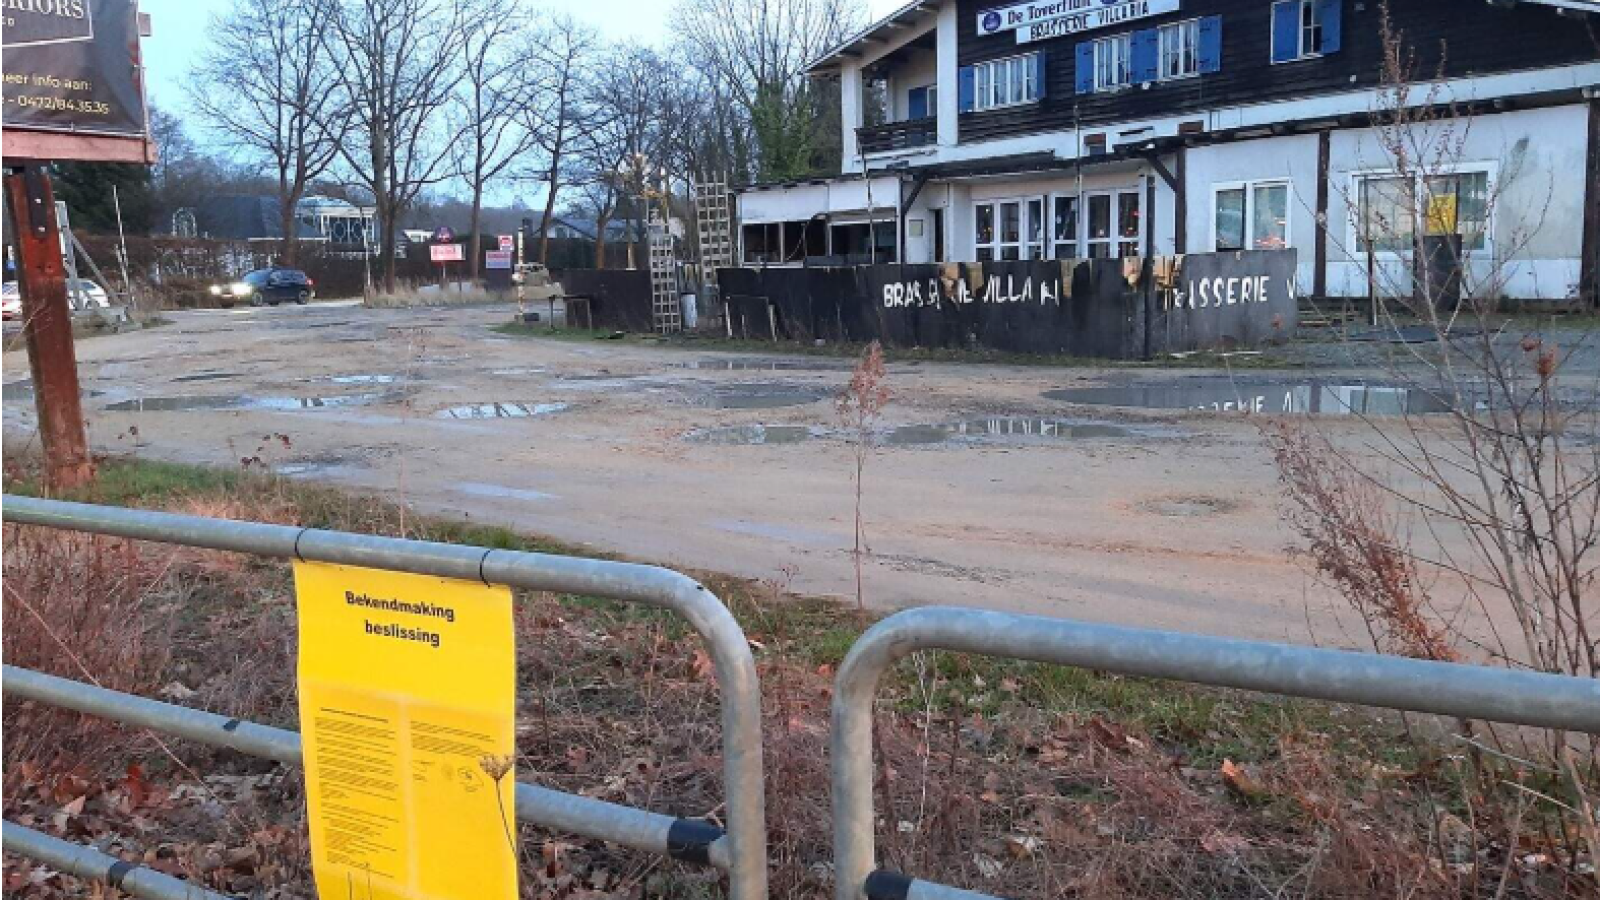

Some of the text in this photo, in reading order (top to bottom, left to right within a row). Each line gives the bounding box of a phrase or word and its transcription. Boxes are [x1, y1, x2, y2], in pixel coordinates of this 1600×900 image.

[2, 0, 84, 18] RIORS
[1007, 10, 1023, 25] De
[33, 73, 60, 88] info
[345, 590, 455, 622] Bekendmaking
[364, 619, 440, 647] beslissing
